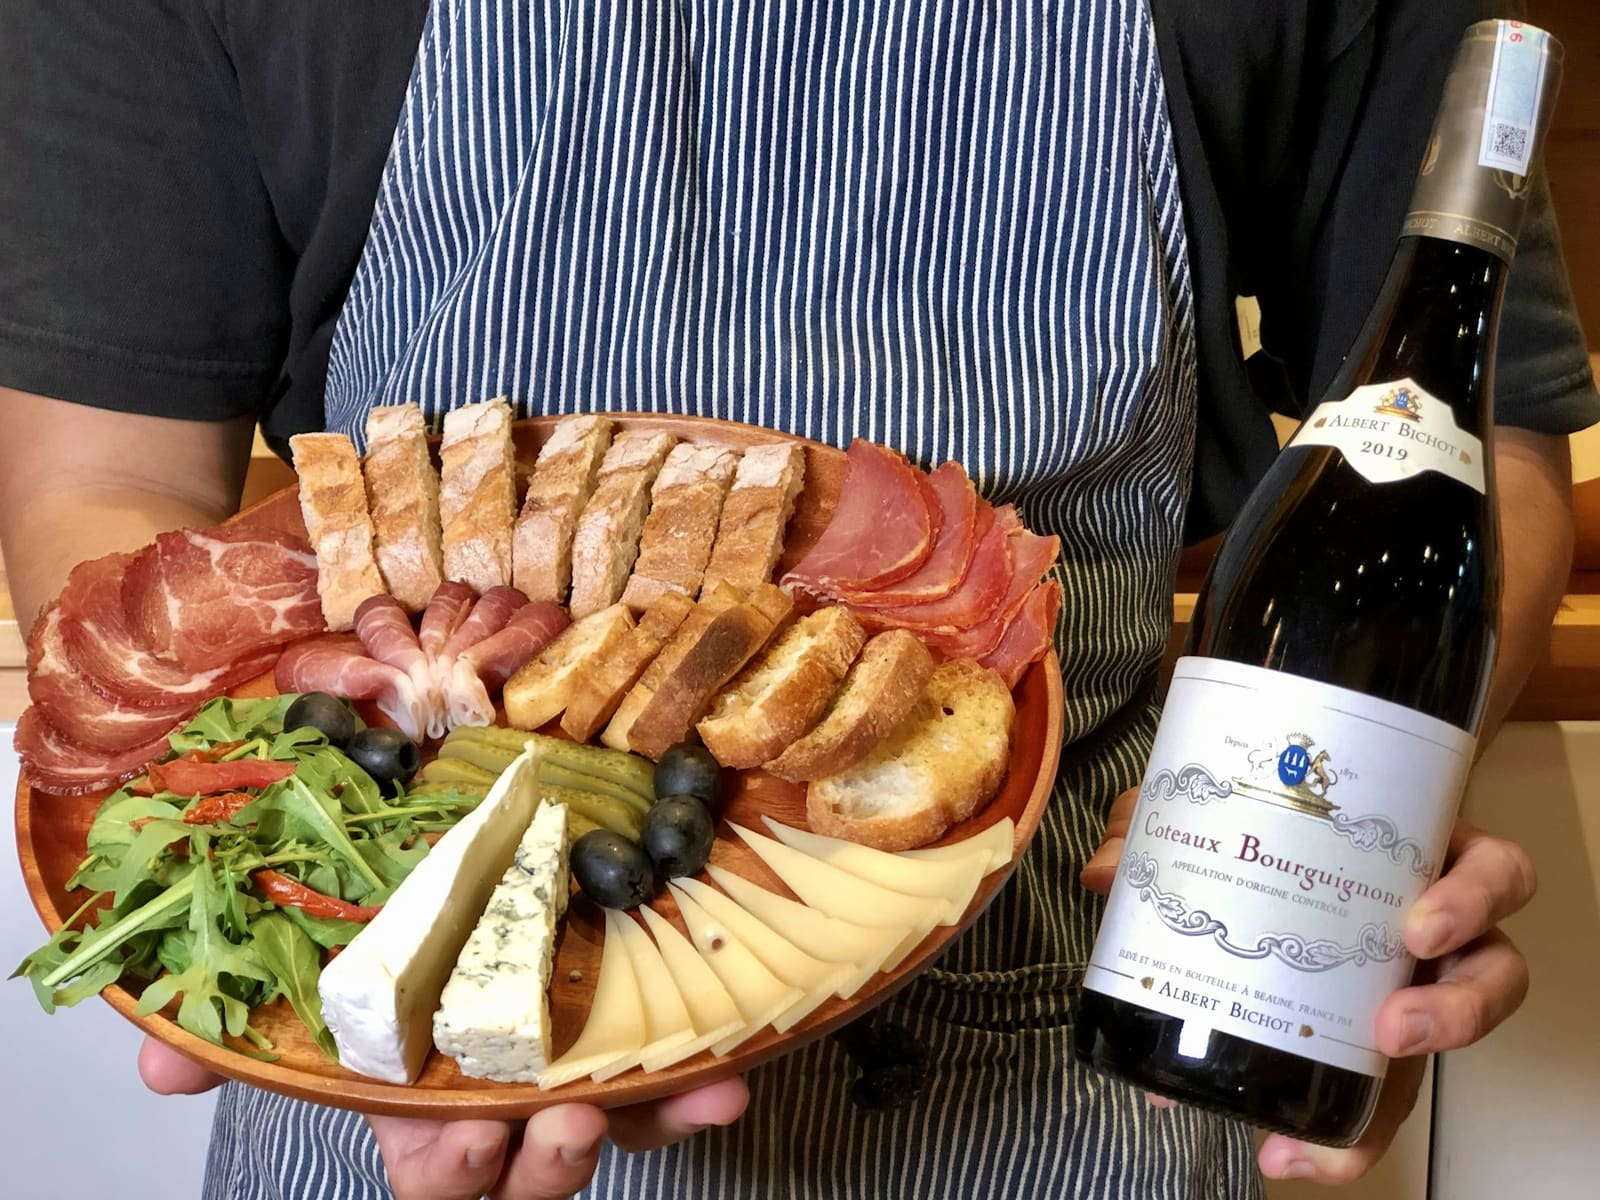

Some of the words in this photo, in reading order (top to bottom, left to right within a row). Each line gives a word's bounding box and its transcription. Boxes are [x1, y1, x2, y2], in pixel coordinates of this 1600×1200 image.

[1454, 223, 1501, 247] ALBERT
[1328, 413, 1391, 433] ALBERT
[1397, 422, 1458, 458] BICHOT
[1360, 440, 1409, 462] 2019
[1224, 735, 1249, 749] Depuis
[1144, 810, 1222, 854] Coteaux
[1234, 832, 1404, 909] Bourguignons
[1171, 859, 1233, 883] APPELLATION
[1235, 876, 1289, 900] D'ORIGINE
[1139, 955, 1150, 966] ET
[1151, 959, 1167, 971] MIS
[1169, 964, 1182, 976] EN
[1185, 969, 1238, 993] BOUTEILLE
[1298, 1002, 1336, 1022] FRANCE
[1158, 980, 1221, 1012] ALBERT
[1228, 1000, 1294, 1034] BICHOT
